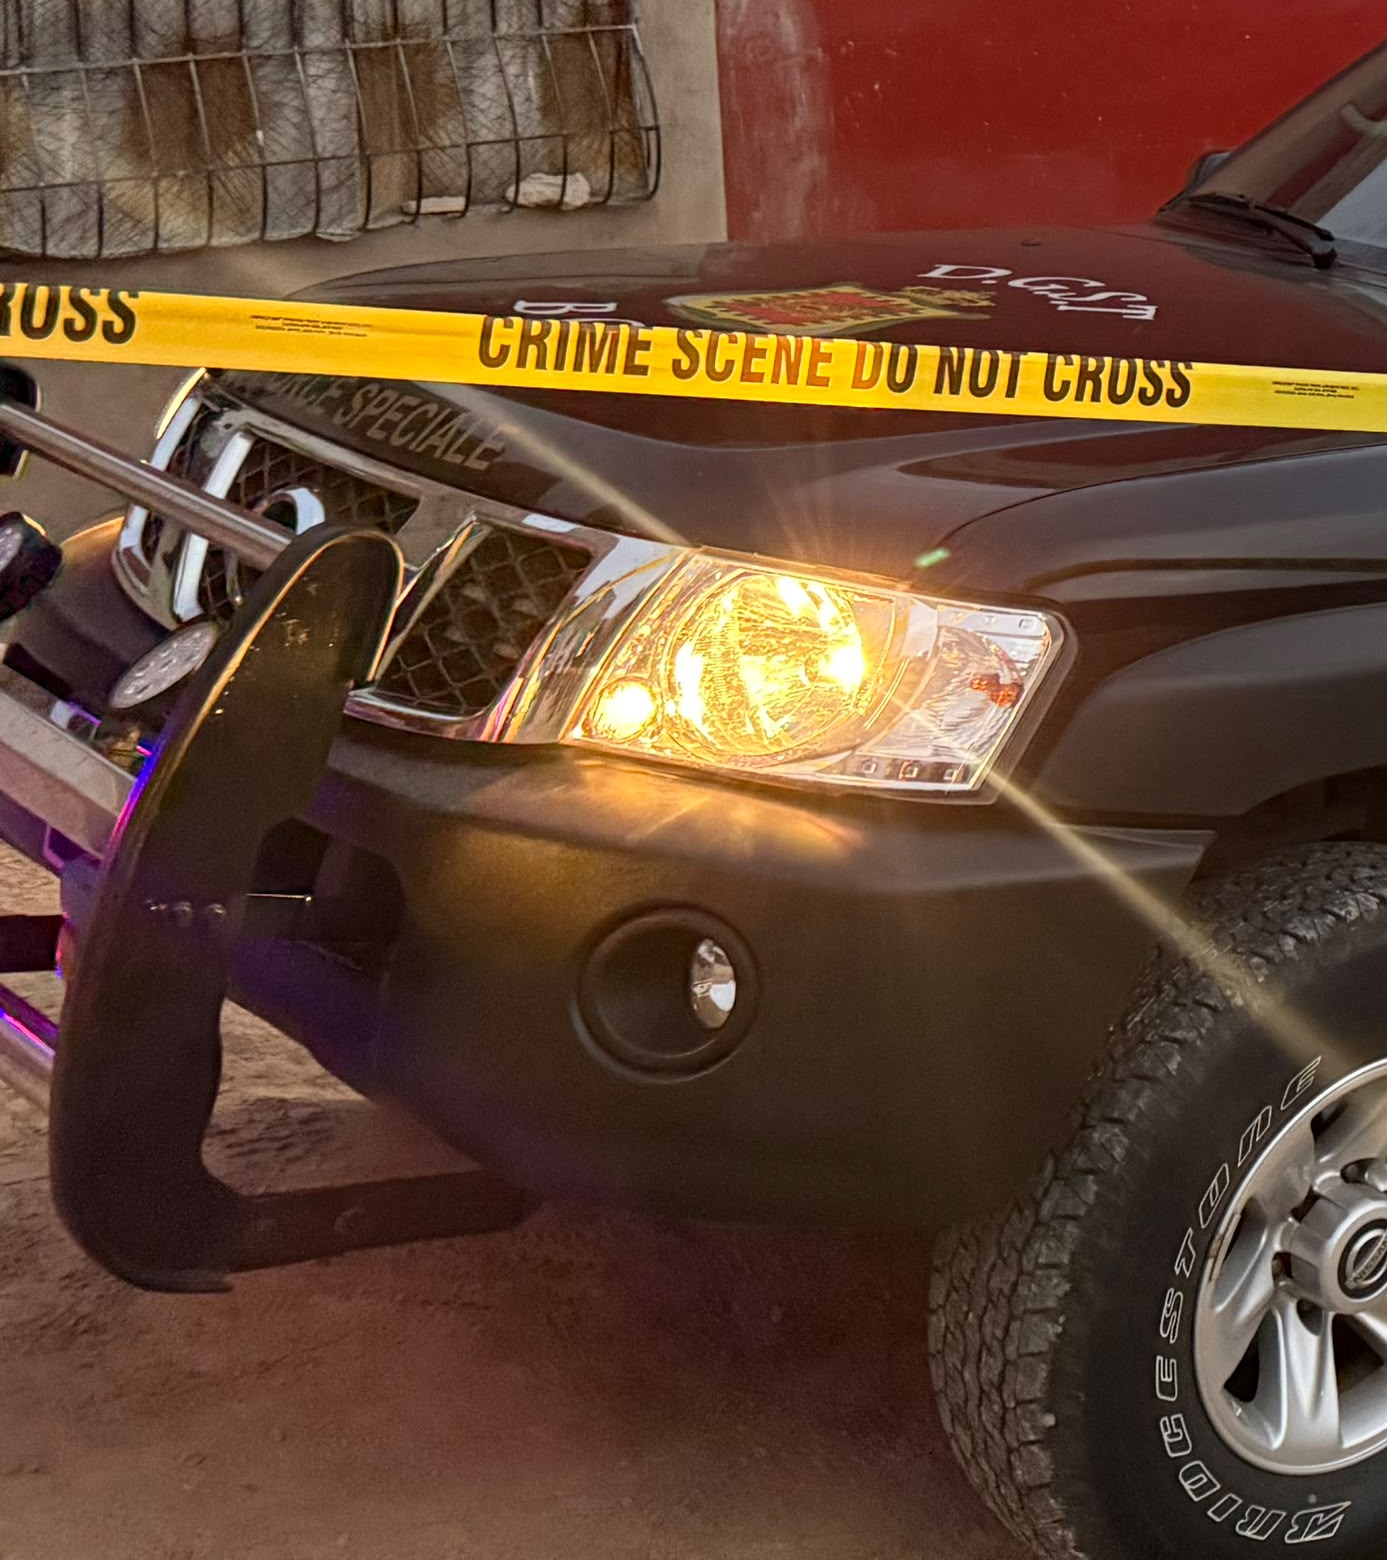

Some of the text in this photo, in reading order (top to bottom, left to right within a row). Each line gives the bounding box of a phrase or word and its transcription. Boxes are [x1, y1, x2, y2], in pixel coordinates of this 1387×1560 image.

[478, 317, 1193, 407] CRIME SCENE DO NOT CROSS
[332, 383, 506, 470] SPECIALE
[1155, 1055, 1352, 1545] BRIDGESTONE
